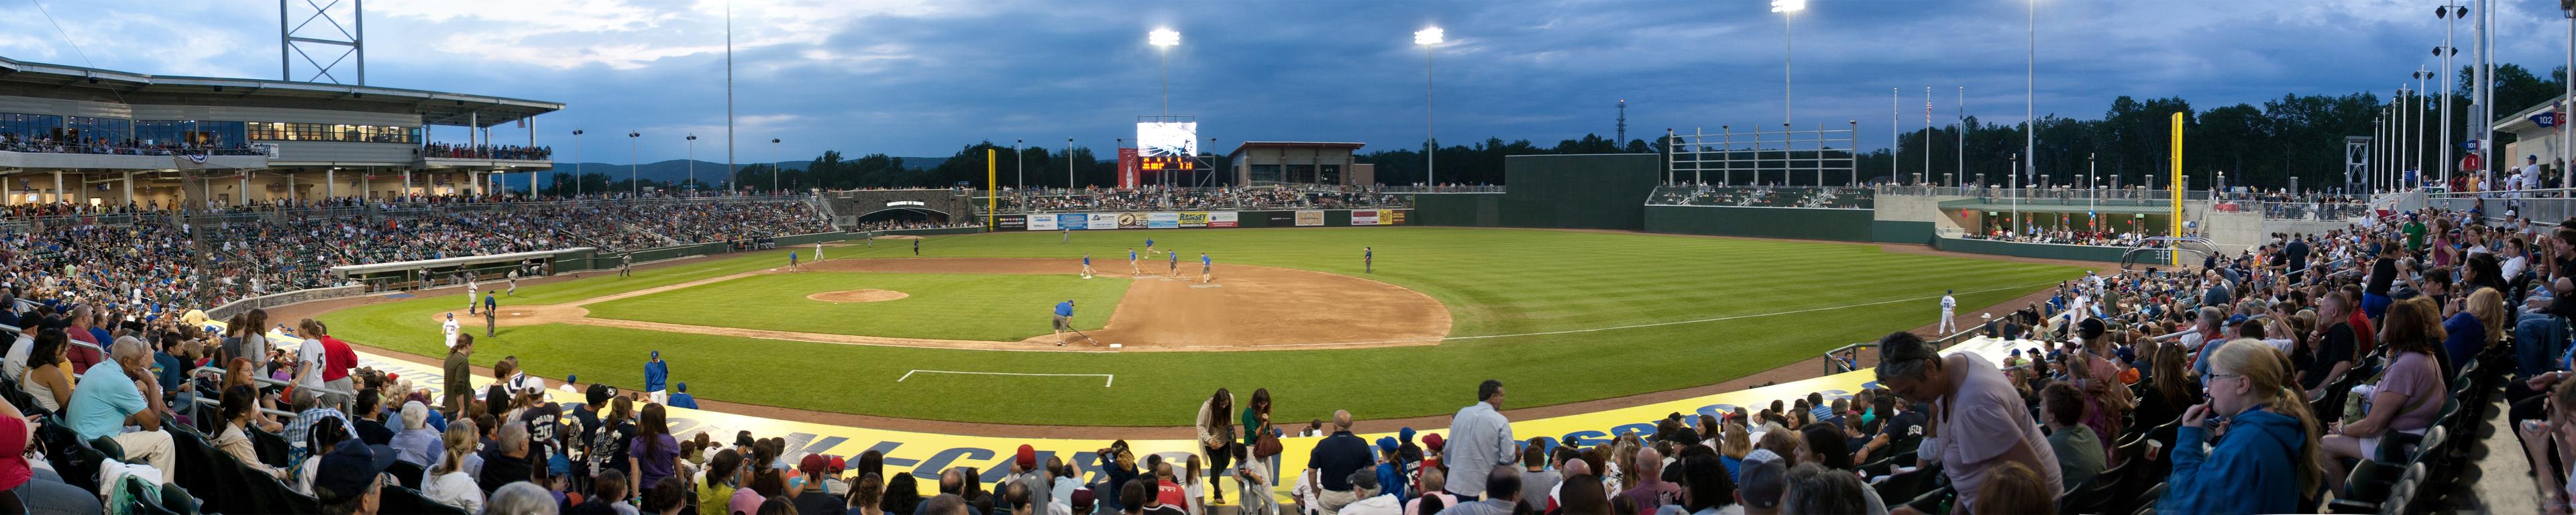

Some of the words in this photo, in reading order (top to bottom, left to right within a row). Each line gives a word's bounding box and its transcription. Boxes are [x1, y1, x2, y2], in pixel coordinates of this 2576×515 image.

[2539, 116, 2553, 124] 102
[317, 353, 323, 370] 5
[532, 414, 555, 427] POSADA
[533, 424, 553, 442] 20
[1907, 424, 1922, 436] JETER
